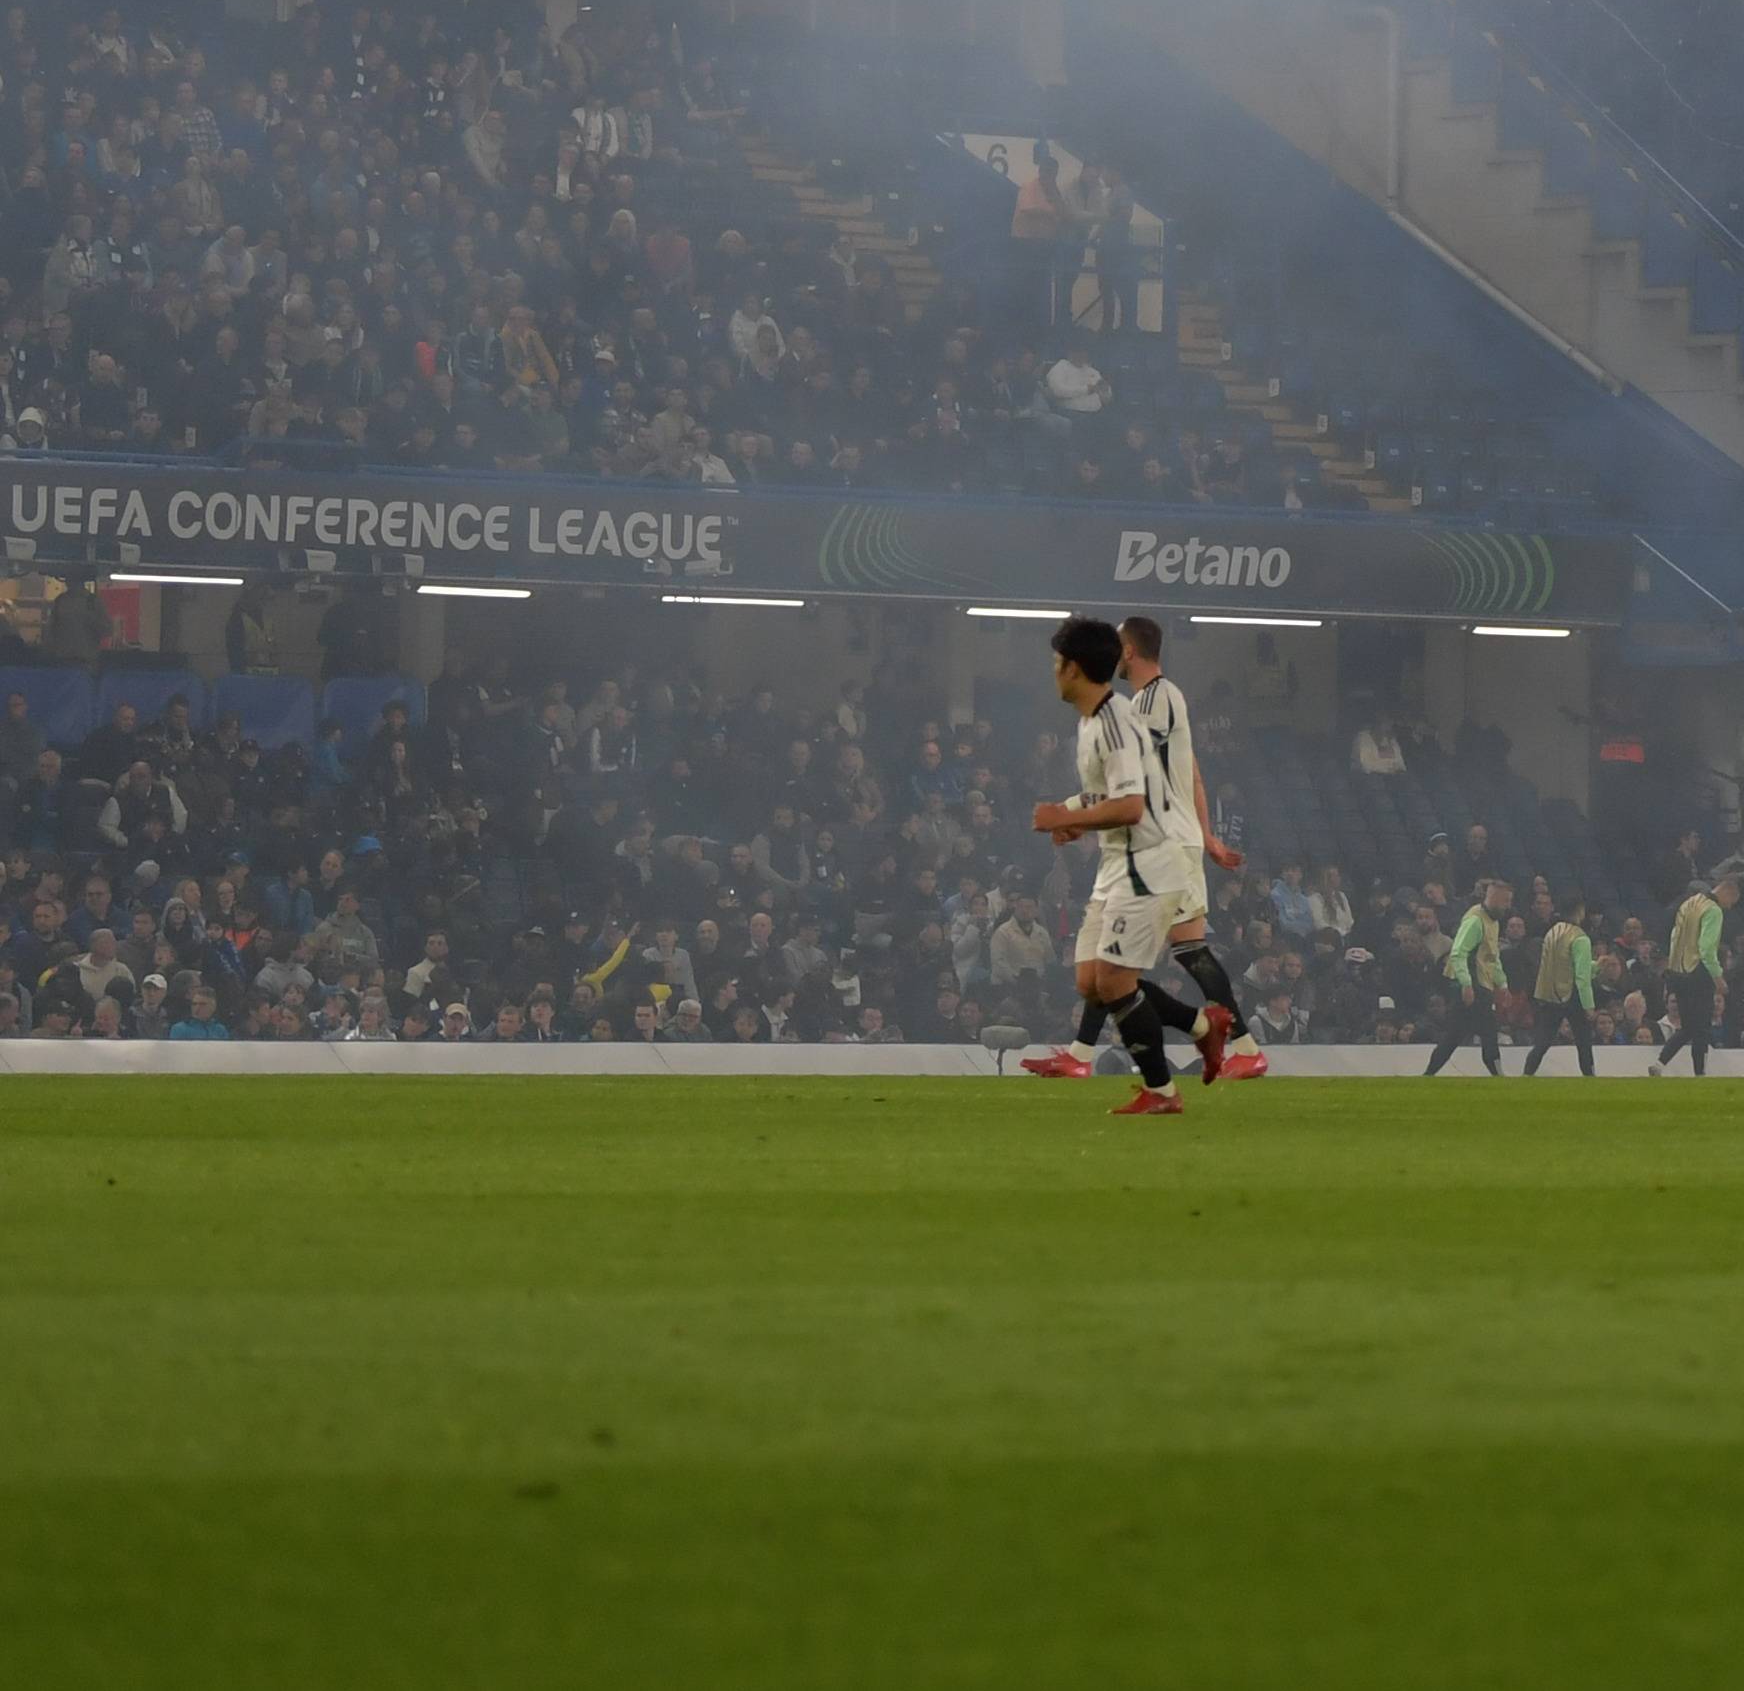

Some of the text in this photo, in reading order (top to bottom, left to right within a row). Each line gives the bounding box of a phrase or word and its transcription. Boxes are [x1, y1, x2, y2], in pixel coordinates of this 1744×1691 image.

[12, 484, 152, 538] UEFA
[167, 490, 510, 552] CONFERENCE
[529, 509, 722, 561] LEAGUE
[1113, 530, 1292, 588] Betano
